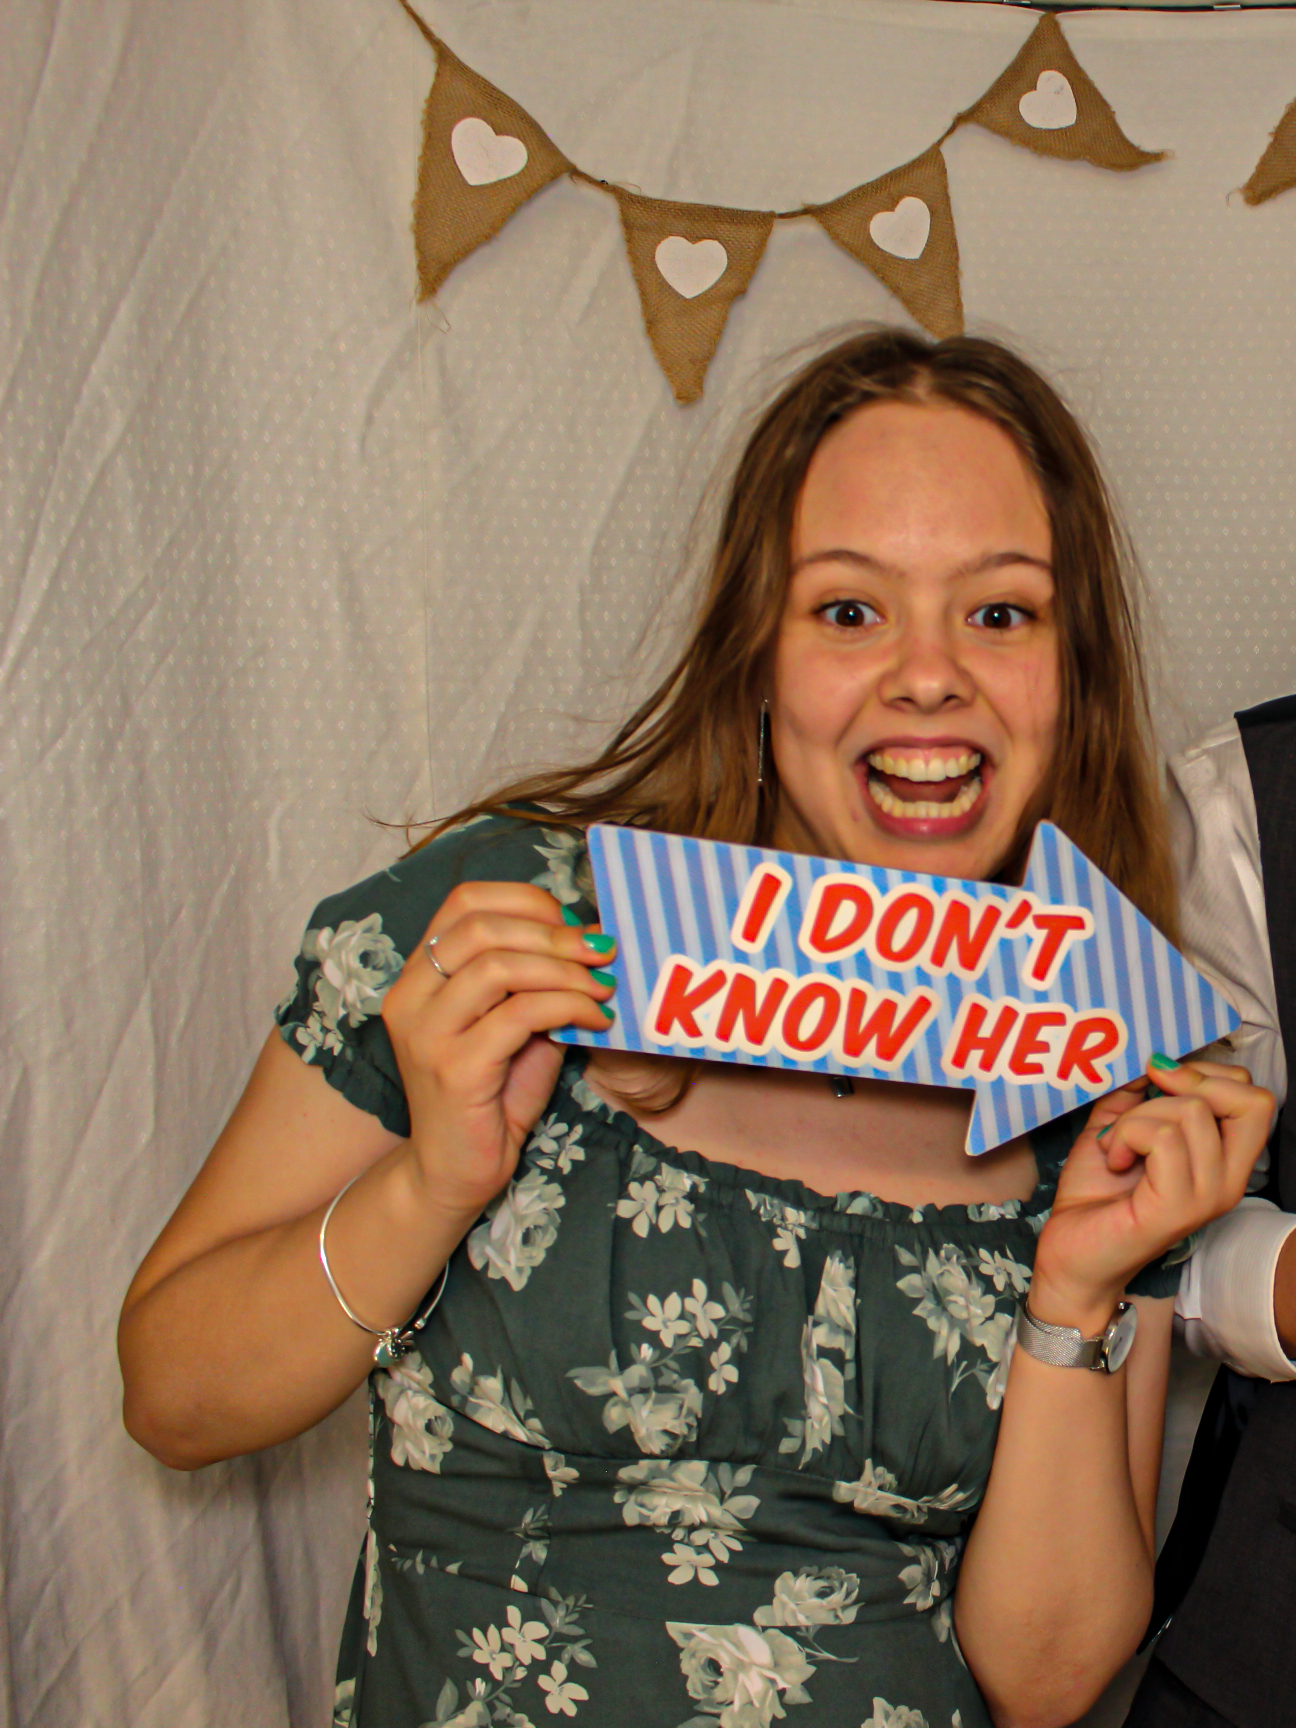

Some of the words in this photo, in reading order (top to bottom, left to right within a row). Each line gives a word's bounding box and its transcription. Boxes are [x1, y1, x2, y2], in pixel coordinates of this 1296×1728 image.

[741, 872, 783, 944] I
[808, 882, 1087, 983] DON'T
[654, 963, 933, 1063] KNOW
[950, 1001, 1120, 1085] HER
